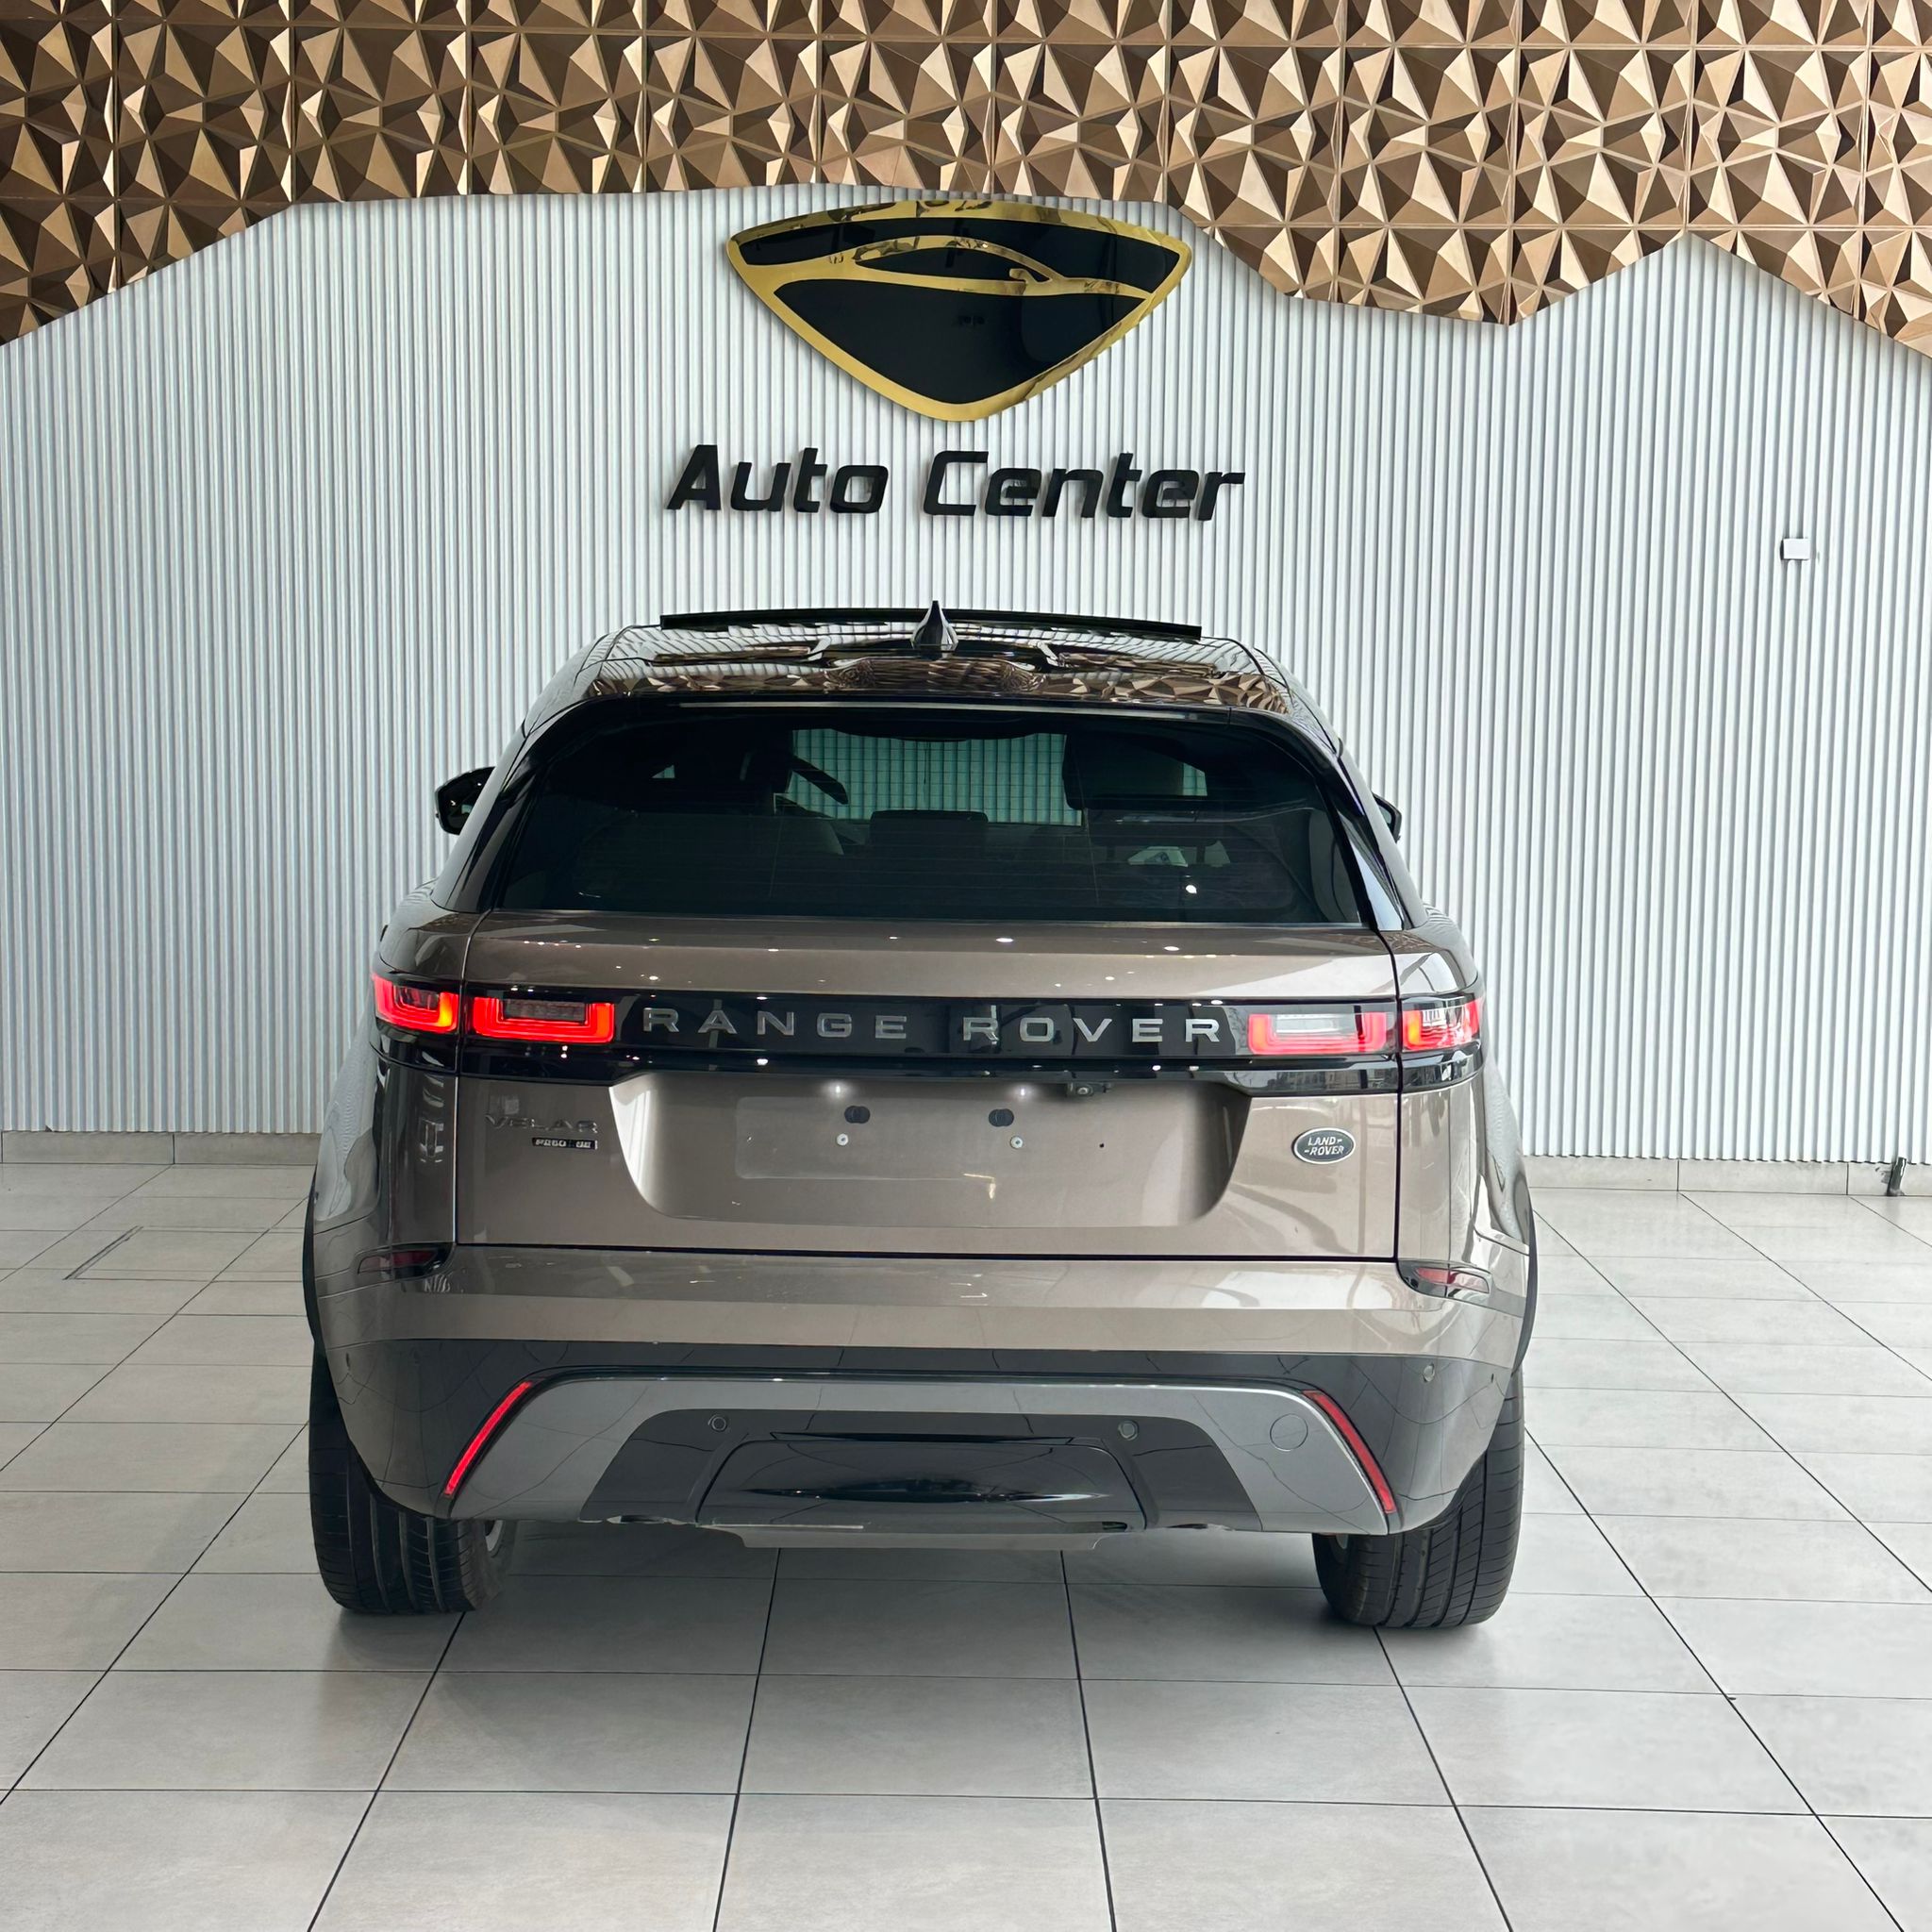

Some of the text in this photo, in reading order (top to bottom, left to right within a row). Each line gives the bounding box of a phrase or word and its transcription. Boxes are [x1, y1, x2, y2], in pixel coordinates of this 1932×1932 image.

[668, 444, 1244, 521] Auto Center
[643, 1008, 1221, 1043] RANGE ROVER
